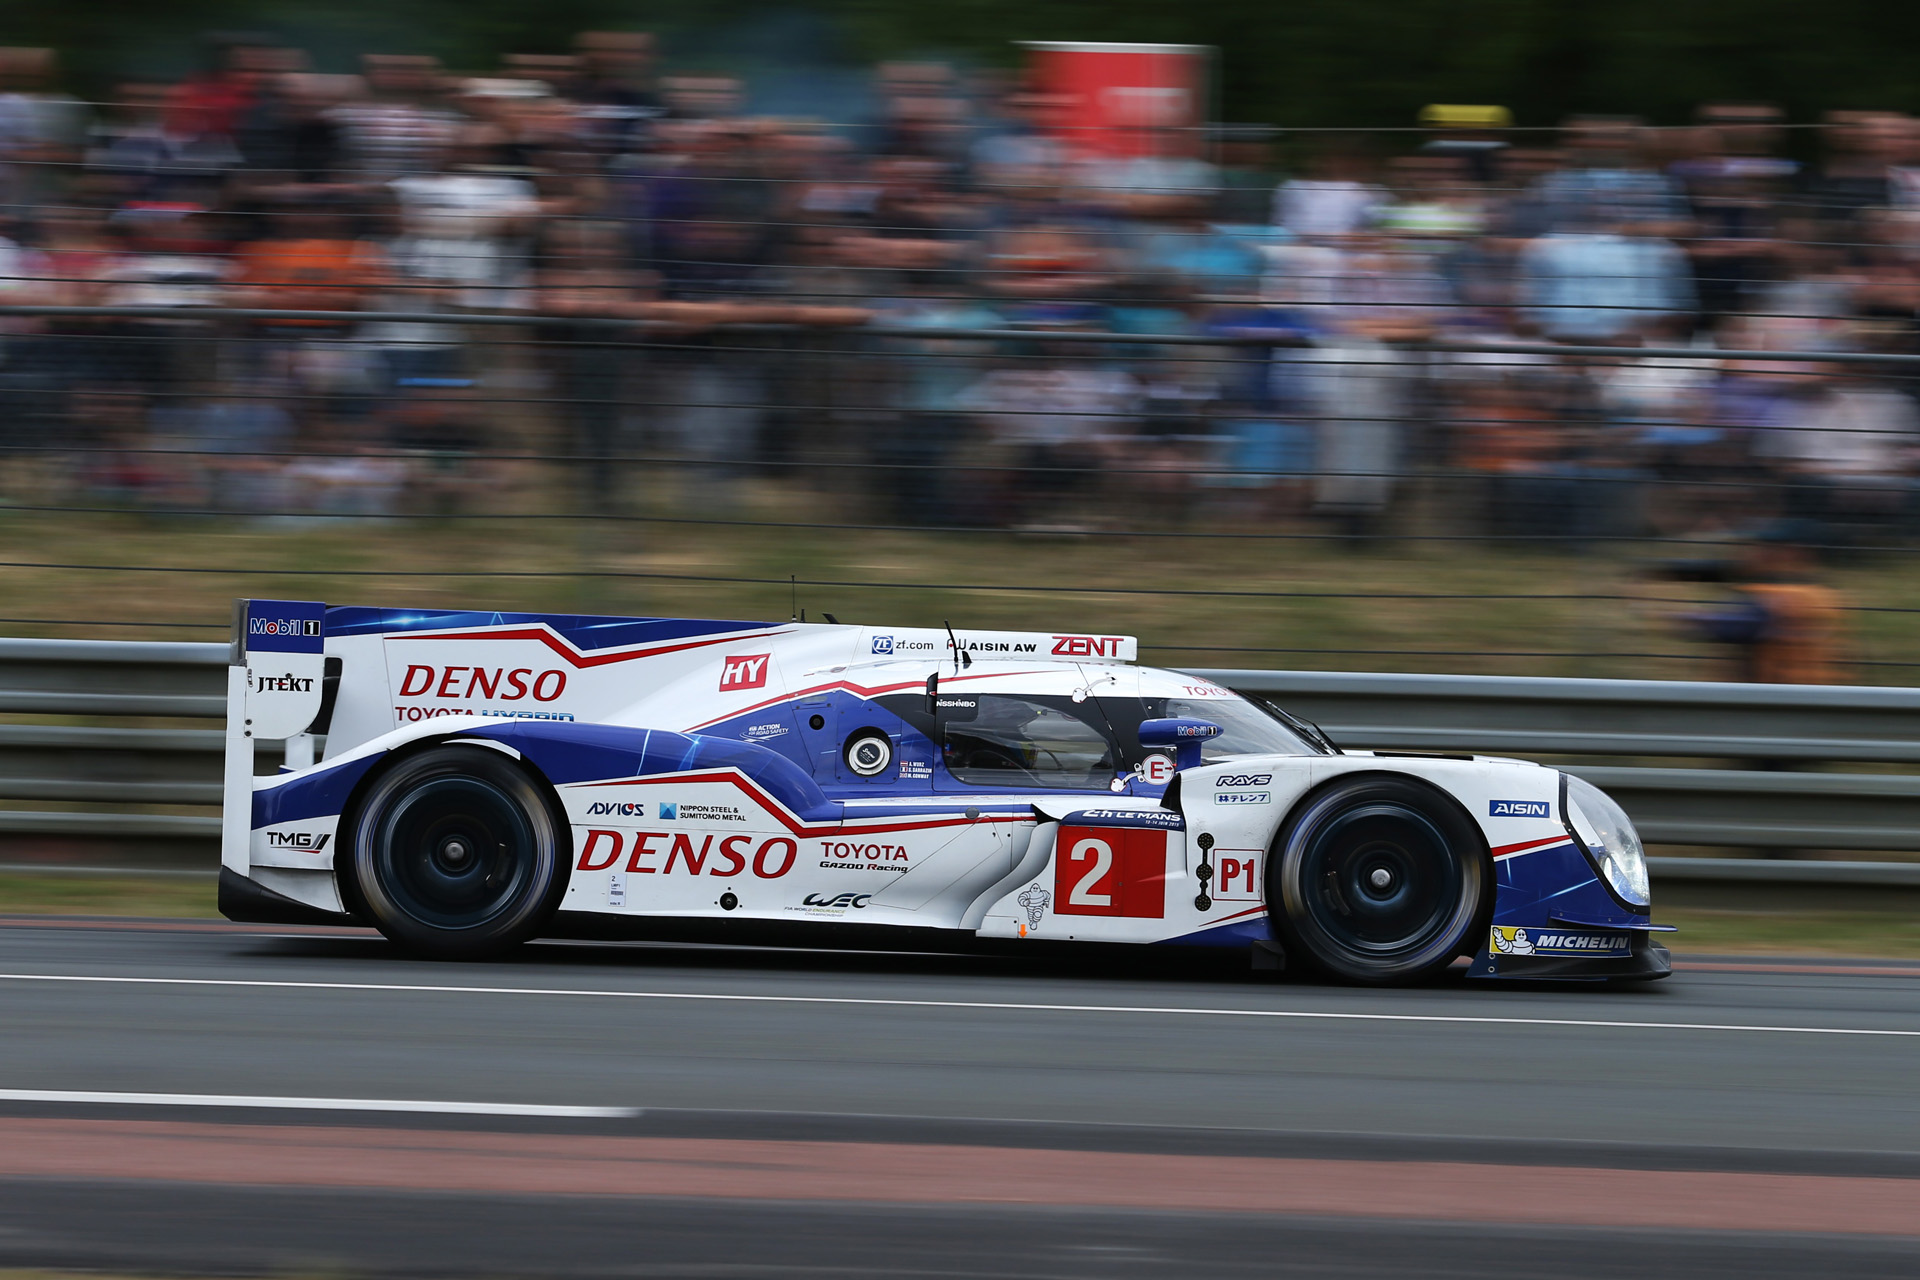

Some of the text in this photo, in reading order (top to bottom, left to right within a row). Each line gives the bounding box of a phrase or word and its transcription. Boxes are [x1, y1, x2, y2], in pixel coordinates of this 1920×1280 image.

[250, 618, 300, 636] Mobil
[876, 638, 890, 648] ZF
[896, 640, 934, 650] zf.com
[968, 642, 1009, 652] AISIN
[1014, 644, 1036, 652] AW
[1051, 636, 1124, 656] ZENT
[722, 656, 767, 685] HY
[256, 676, 314, 693] JTEKT
[398, 664, 566, 702] DENSO
[1178, 726, 1206, 736] Mobil
[1150, 762, 1164, 779] E
[1216, 774, 1272, 786] RAYS
[1218, 794, 1268, 803] 林テレンプ
[680, 812, 720, 820] SUMITOMO
[1494, 803, 1546, 816] AISIN
[1137, 812, 1180, 822] MANS
[266, 832, 312, 846] TMG
[576, 830, 797, 879] DENSO
[820, 842, 909, 861] TOYOTA
[820, 861, 908, 873] GAZOO Racing
[1068, 838, 1112, 906] 2
[1221, 858, 1254, 892] P1
[802, 892, 872, 908] WEC
[1536, 935, 1628, 949] MICHELIN
